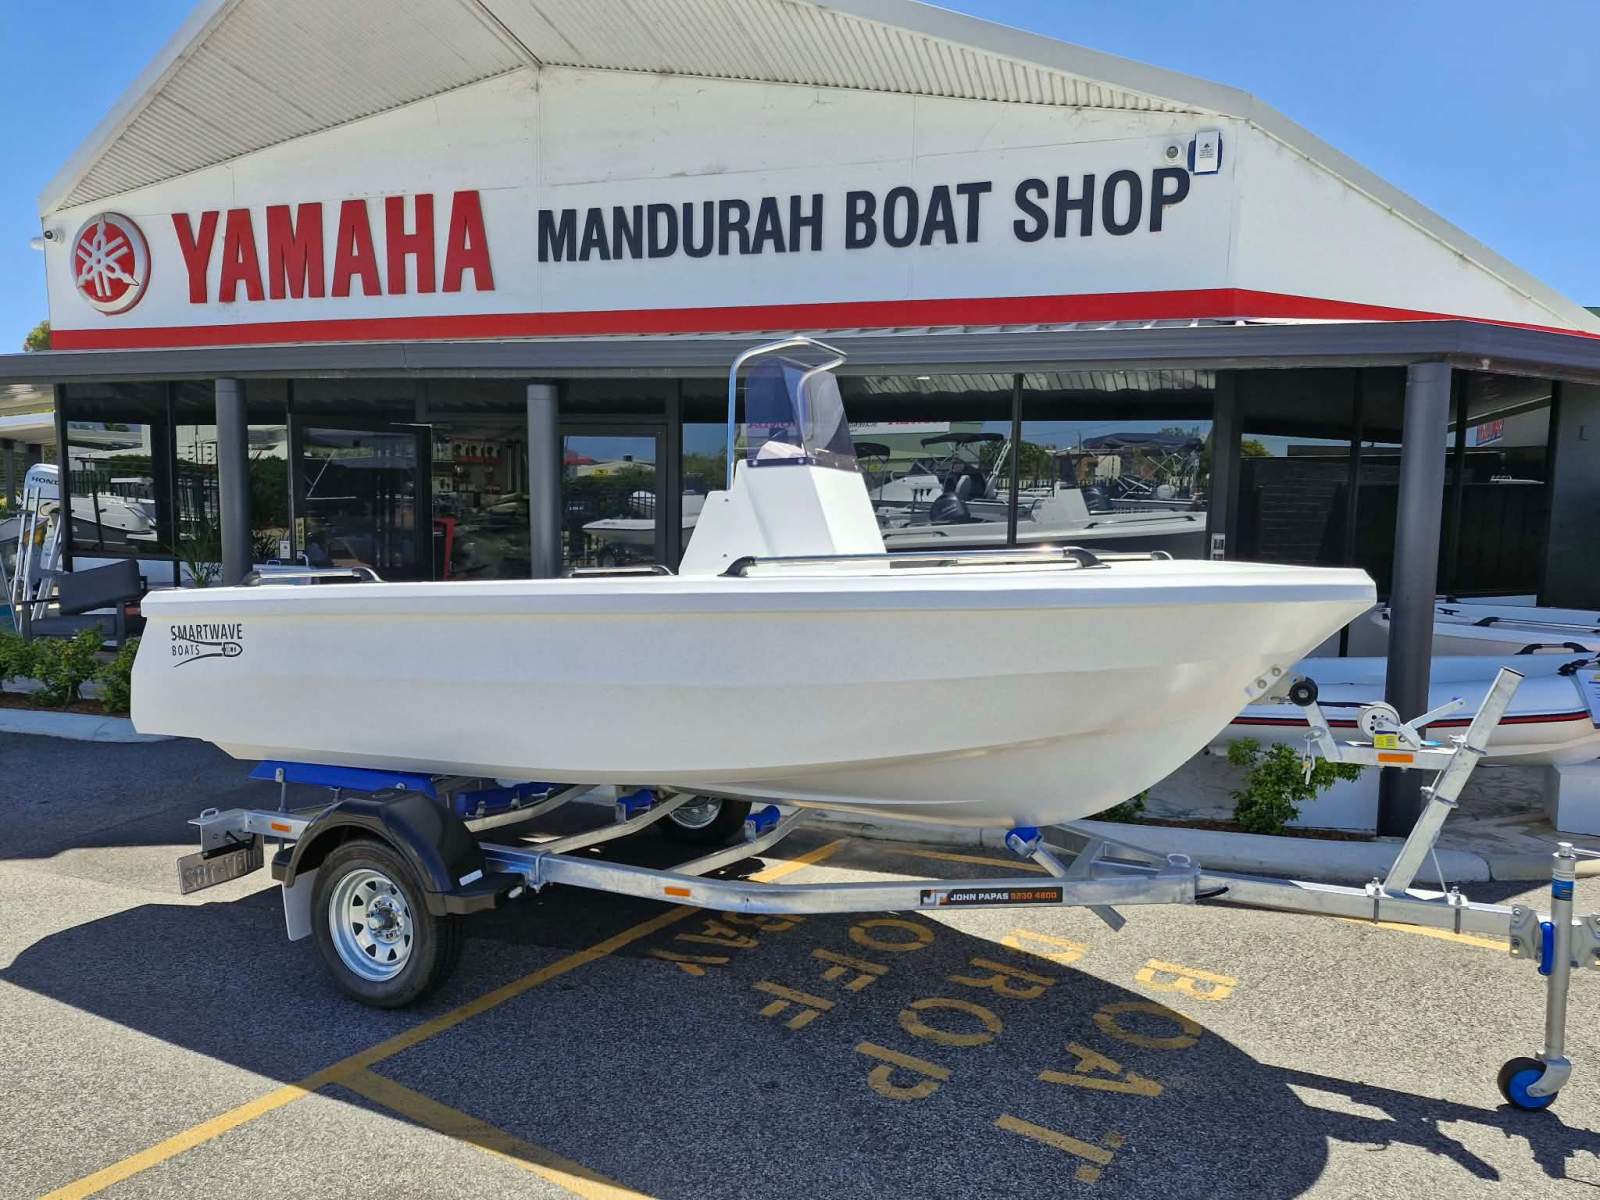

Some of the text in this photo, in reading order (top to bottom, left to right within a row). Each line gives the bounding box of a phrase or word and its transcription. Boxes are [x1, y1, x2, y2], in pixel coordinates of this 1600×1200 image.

[172, 190, 495, 303] YAMAHA
[538, 167, 1190, 262] MANDURAH BOAT SHOP
[31, 476, 60, 485] HOND
[170, 623, 243, 641] SMARTWAVE
[171, 644, 200, 656] BOATS
[950, 892, 977, 901] JOHN
[978, 891, 1009, 900] PAPAS
[752, 918, 936, 1030] OFF
[856, 928, 1087, 1100] DROP
[995, 959, 1239, 1184] BOAT
